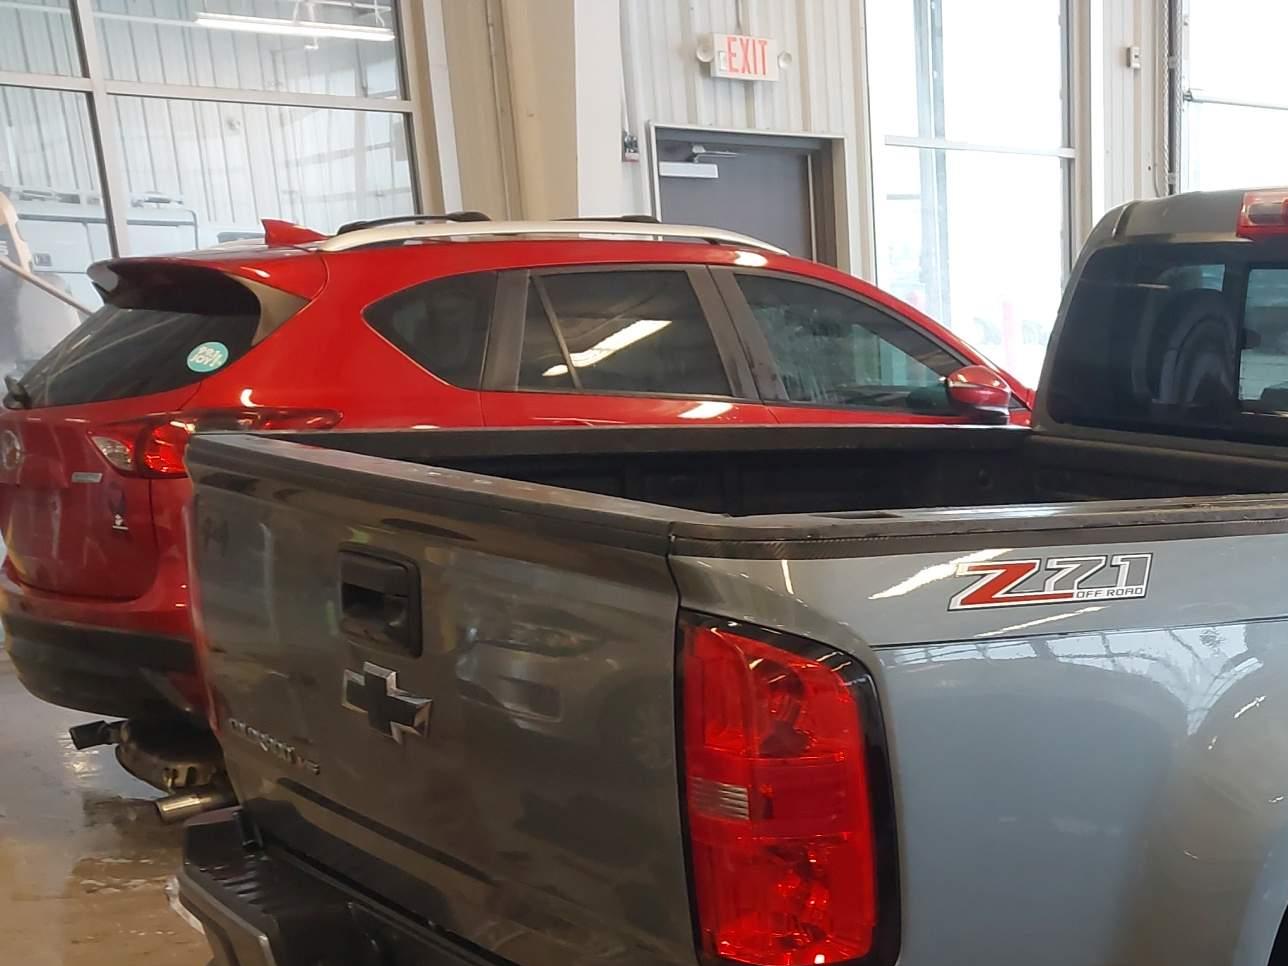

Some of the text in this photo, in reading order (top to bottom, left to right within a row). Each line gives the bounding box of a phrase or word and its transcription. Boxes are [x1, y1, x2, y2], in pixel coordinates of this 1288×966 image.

[726, 36, 768, 76] EXIT
[947, 552, 1153, 611] Z71
[1076, 586, 1144, 599] OFF ROAD
